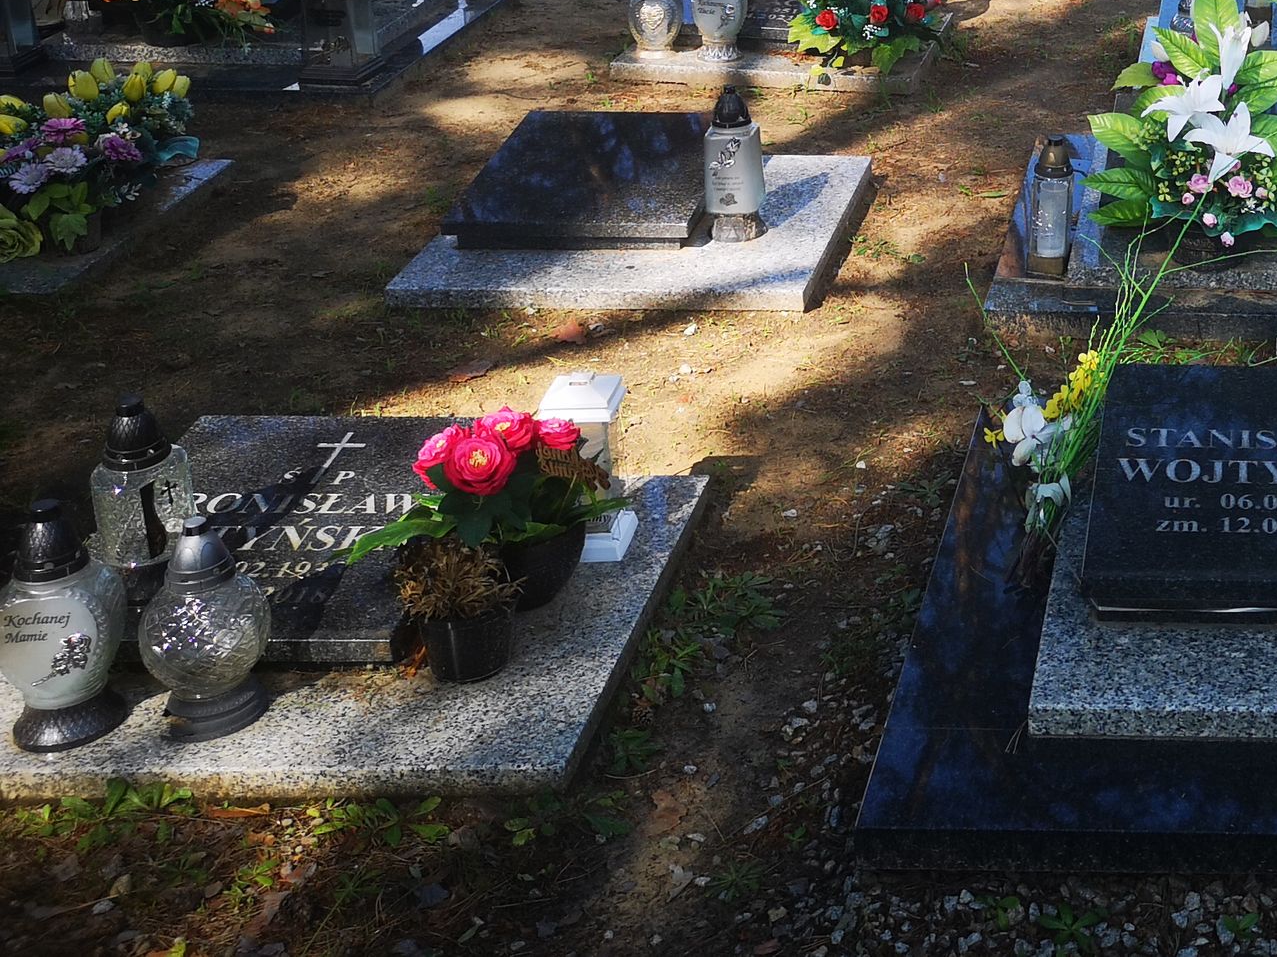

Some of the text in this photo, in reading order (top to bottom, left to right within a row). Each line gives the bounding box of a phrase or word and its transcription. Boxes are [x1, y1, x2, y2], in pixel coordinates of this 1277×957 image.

[330, 470, 356, 485] P
[192, 493, 442, 515] RONISŁAW
[1164, 495, 1201, 510] ur.
[1155, 518, 1207, 533] zm.
[3, 611, 71, 627] Kochanej
[5, 631, 48, 643] Mamie
